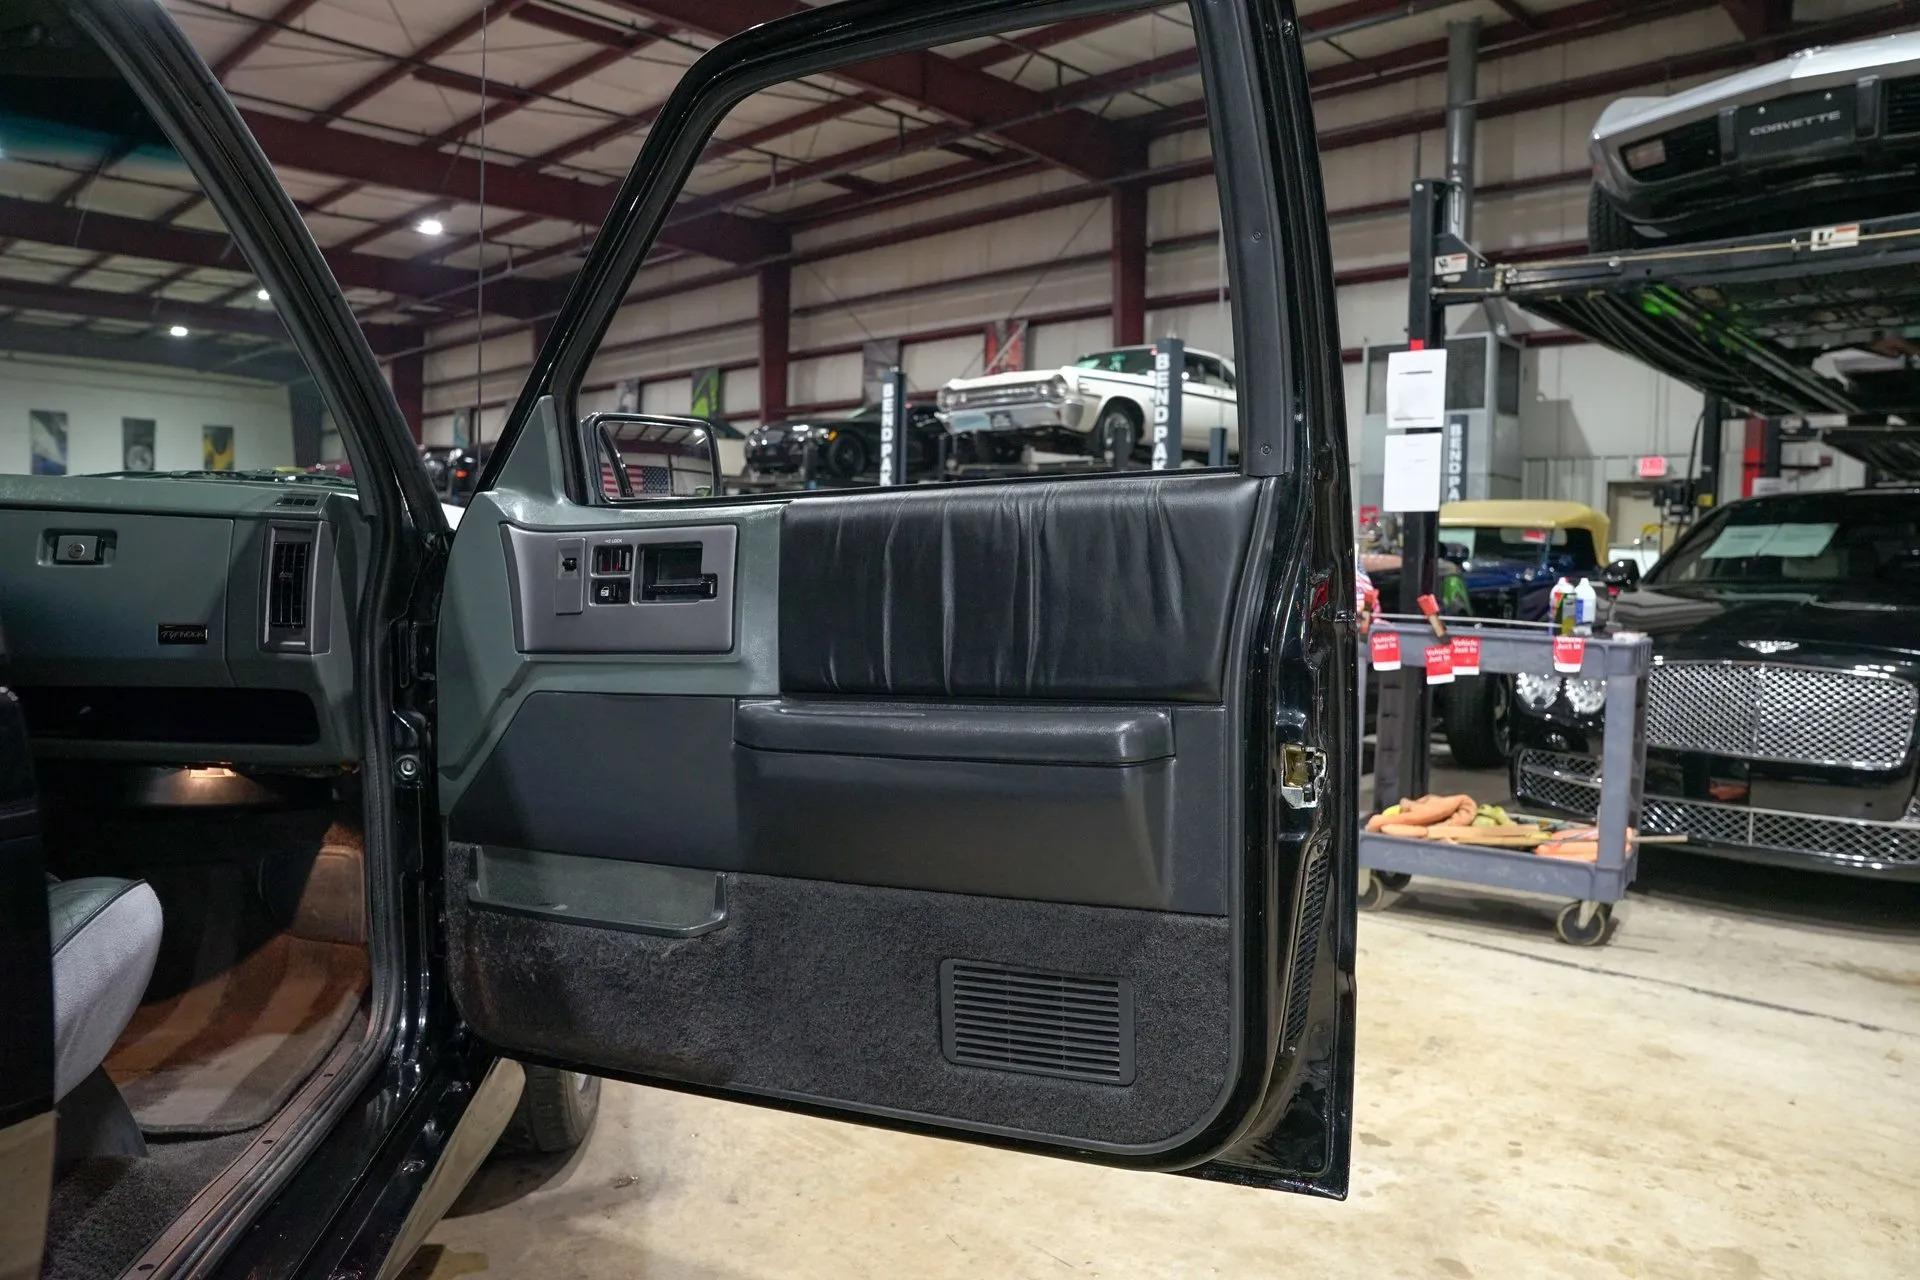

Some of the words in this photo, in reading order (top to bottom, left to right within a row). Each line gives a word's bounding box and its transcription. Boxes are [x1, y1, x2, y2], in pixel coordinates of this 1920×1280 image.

[1750, 110, 1841, 136] CORVETTE
[1152, 353, 1170, 470] BENDPAK
[1448, 423, 1462, 502] BENDPA
[1453, 638, 1478, 647] Vehicle
[1426, 647, 1451, 656] Vehicle
[1454, 646, 1468, 654] Just
[1429, 655, 1442, 663] Just
